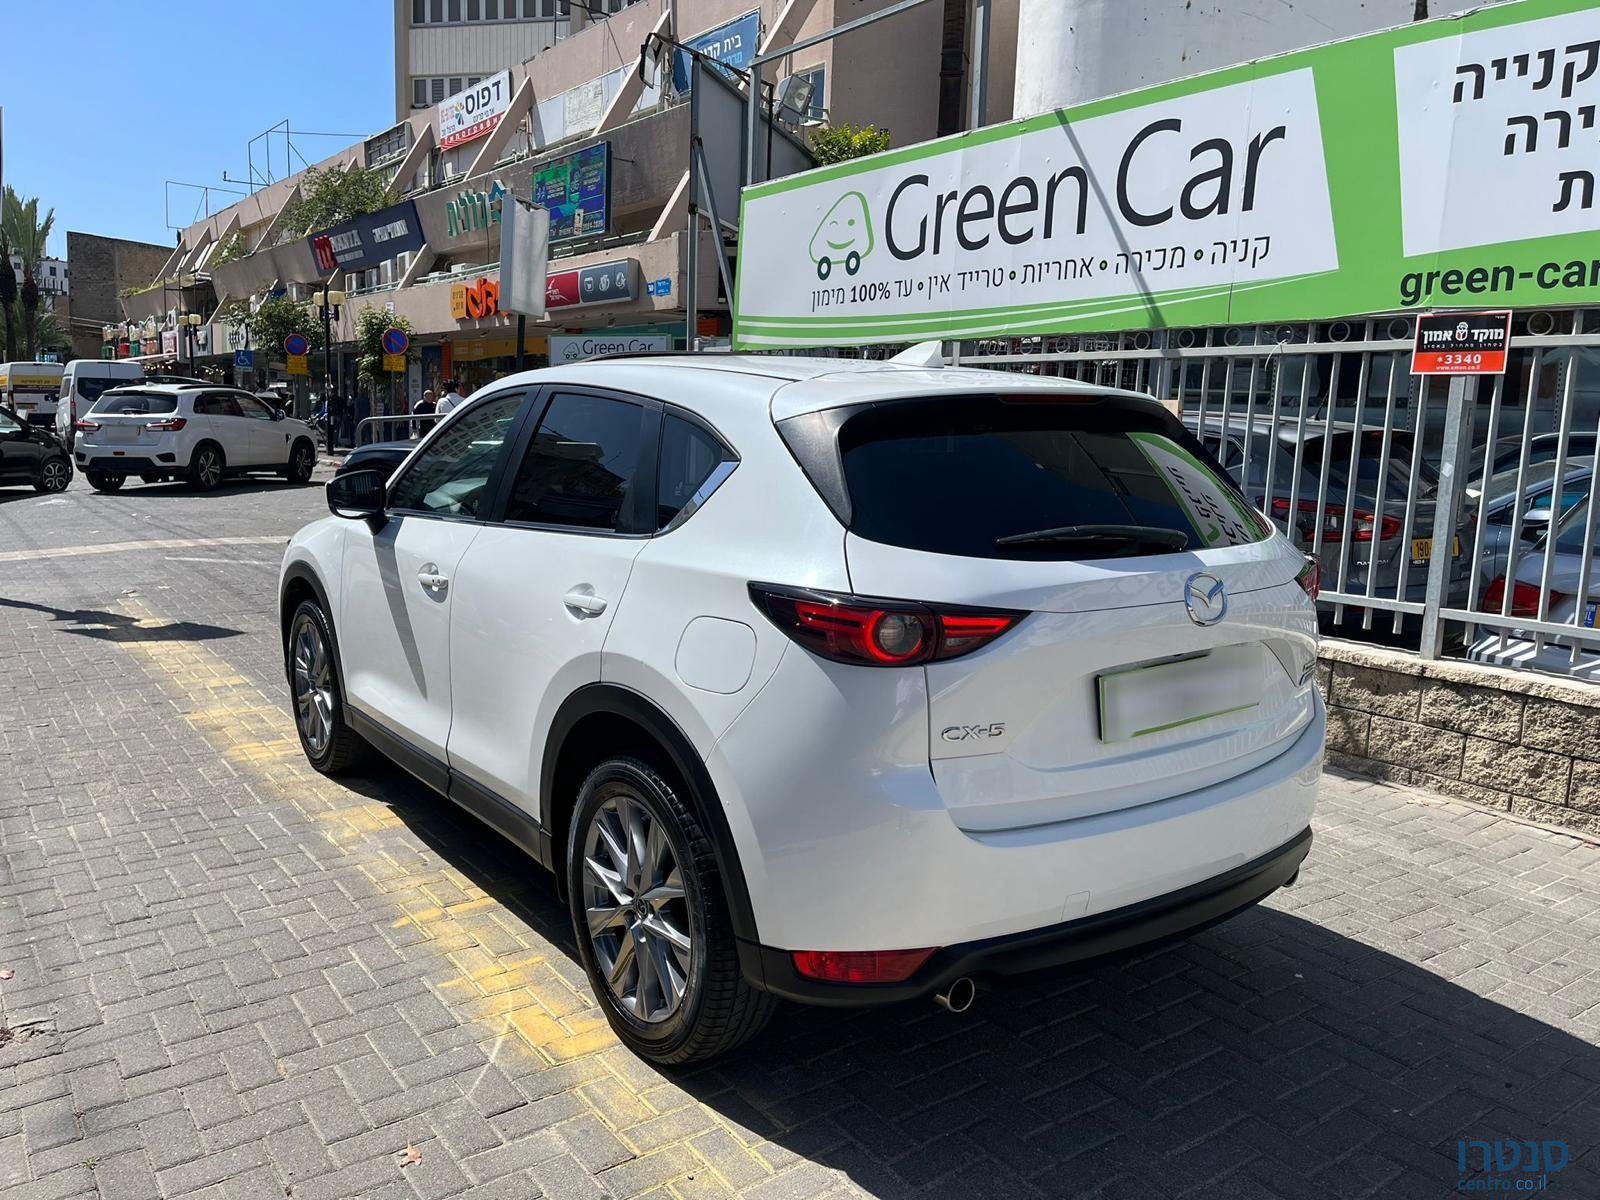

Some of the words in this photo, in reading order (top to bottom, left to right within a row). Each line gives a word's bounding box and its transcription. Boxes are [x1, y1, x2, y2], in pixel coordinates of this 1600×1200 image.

[723, 34, 742, 53] בית
[1453, 40, 1600, 103] קנייה
[464, 80, 501, 115] דפוס
[1504, 105, 1600, 155] ירה
[885, 165, 1089, 261] Green
[1116, 118, 1286, 227] Car
[1115, 246, 1185, 275] מכירה
[1211, 236, 1270, 268] קניה
[957, 267, 1004, 291] טרייד
[1021, 256, 1094, 285] אחריות
[811, 286, 845, 312] מימון
[850, 282, 890, 303] 100%
[894, 278, 913, 298] עד
[927, 273, 951, 300] אין
[582, 340, 625, 355] Green
[628, 340, 654, 352] Car
[1423, 330, 1453, 344] אמון
[1471, 328, 1505, 342] מוקד
[941, 722, 1006, 742] CX-5
